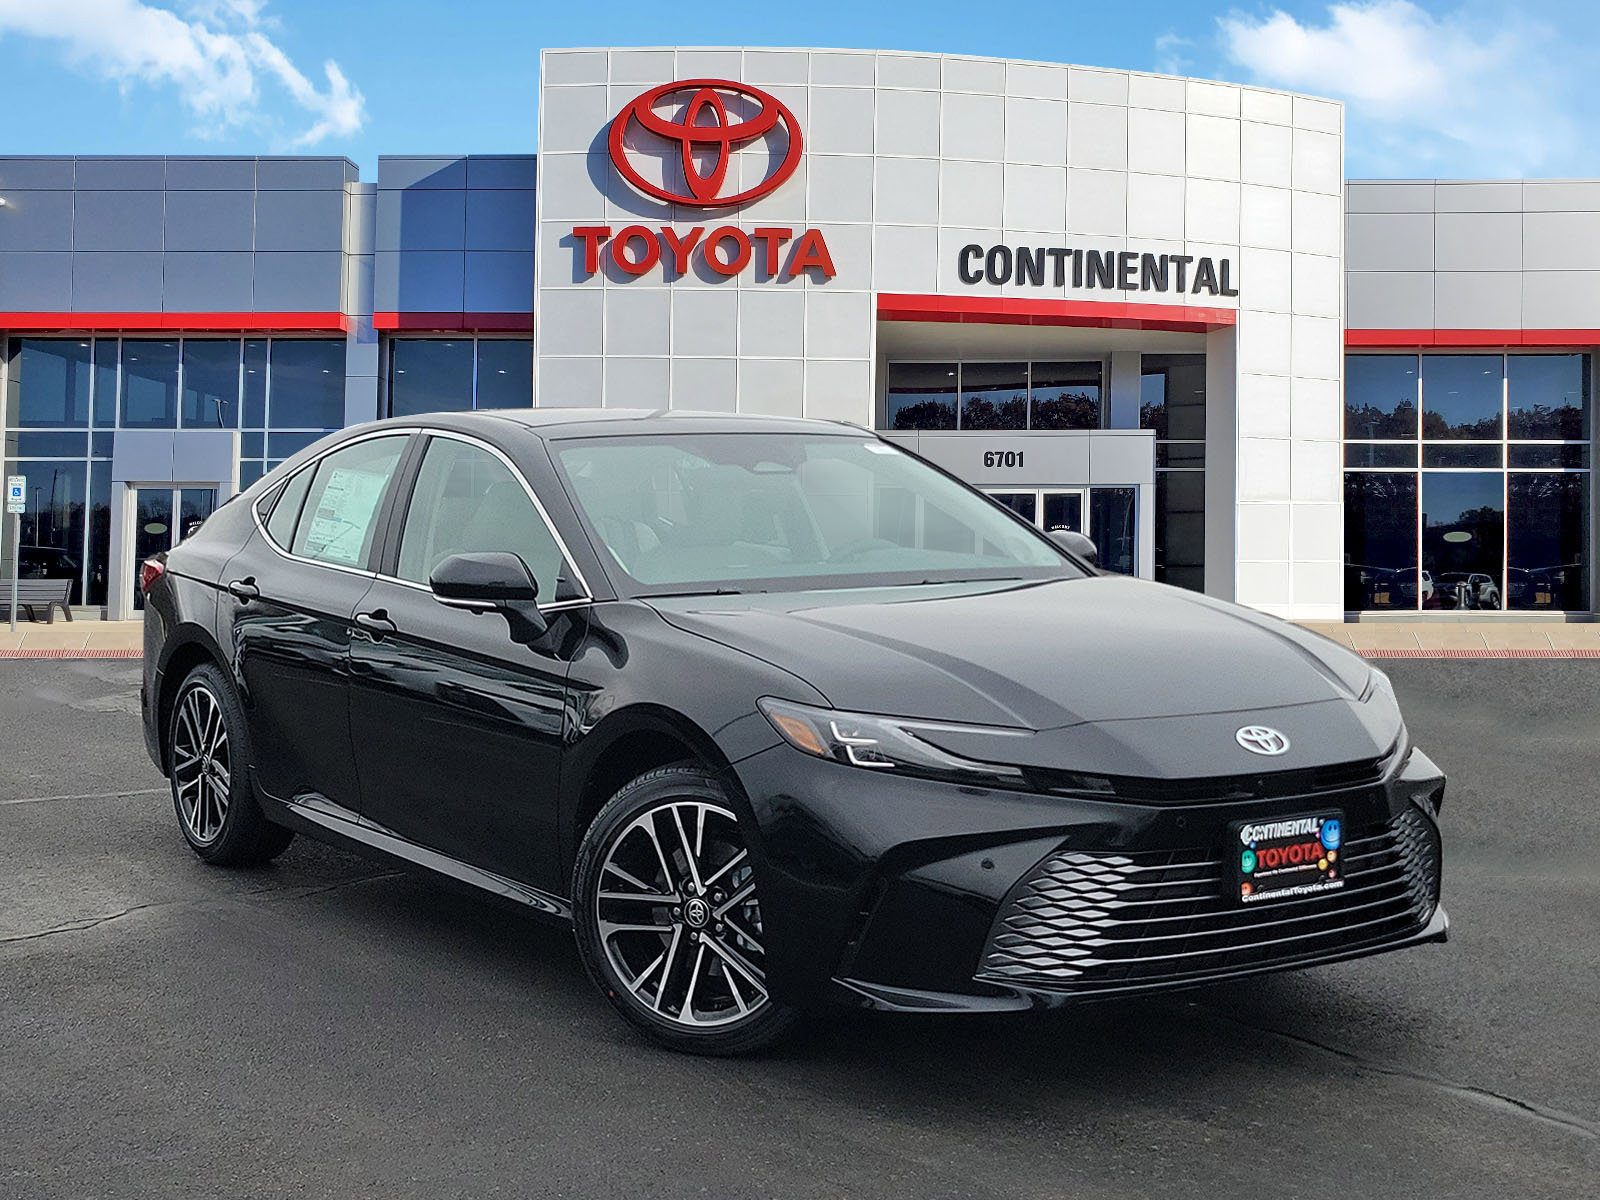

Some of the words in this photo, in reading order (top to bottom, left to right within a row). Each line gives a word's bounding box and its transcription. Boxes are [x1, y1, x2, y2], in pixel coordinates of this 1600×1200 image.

[572, 225, 837, 277] TOYOTA
[958, 244, 1239, 297] CONTINENTAL
[984, 451, 1024, 468] 6701
[1240, 817, 1320, 846] CONTINENTAL
[1256, 842, 1325, 869] TOYOTA
[1241, 880, 1345, 903] ContinentalToyota.com
